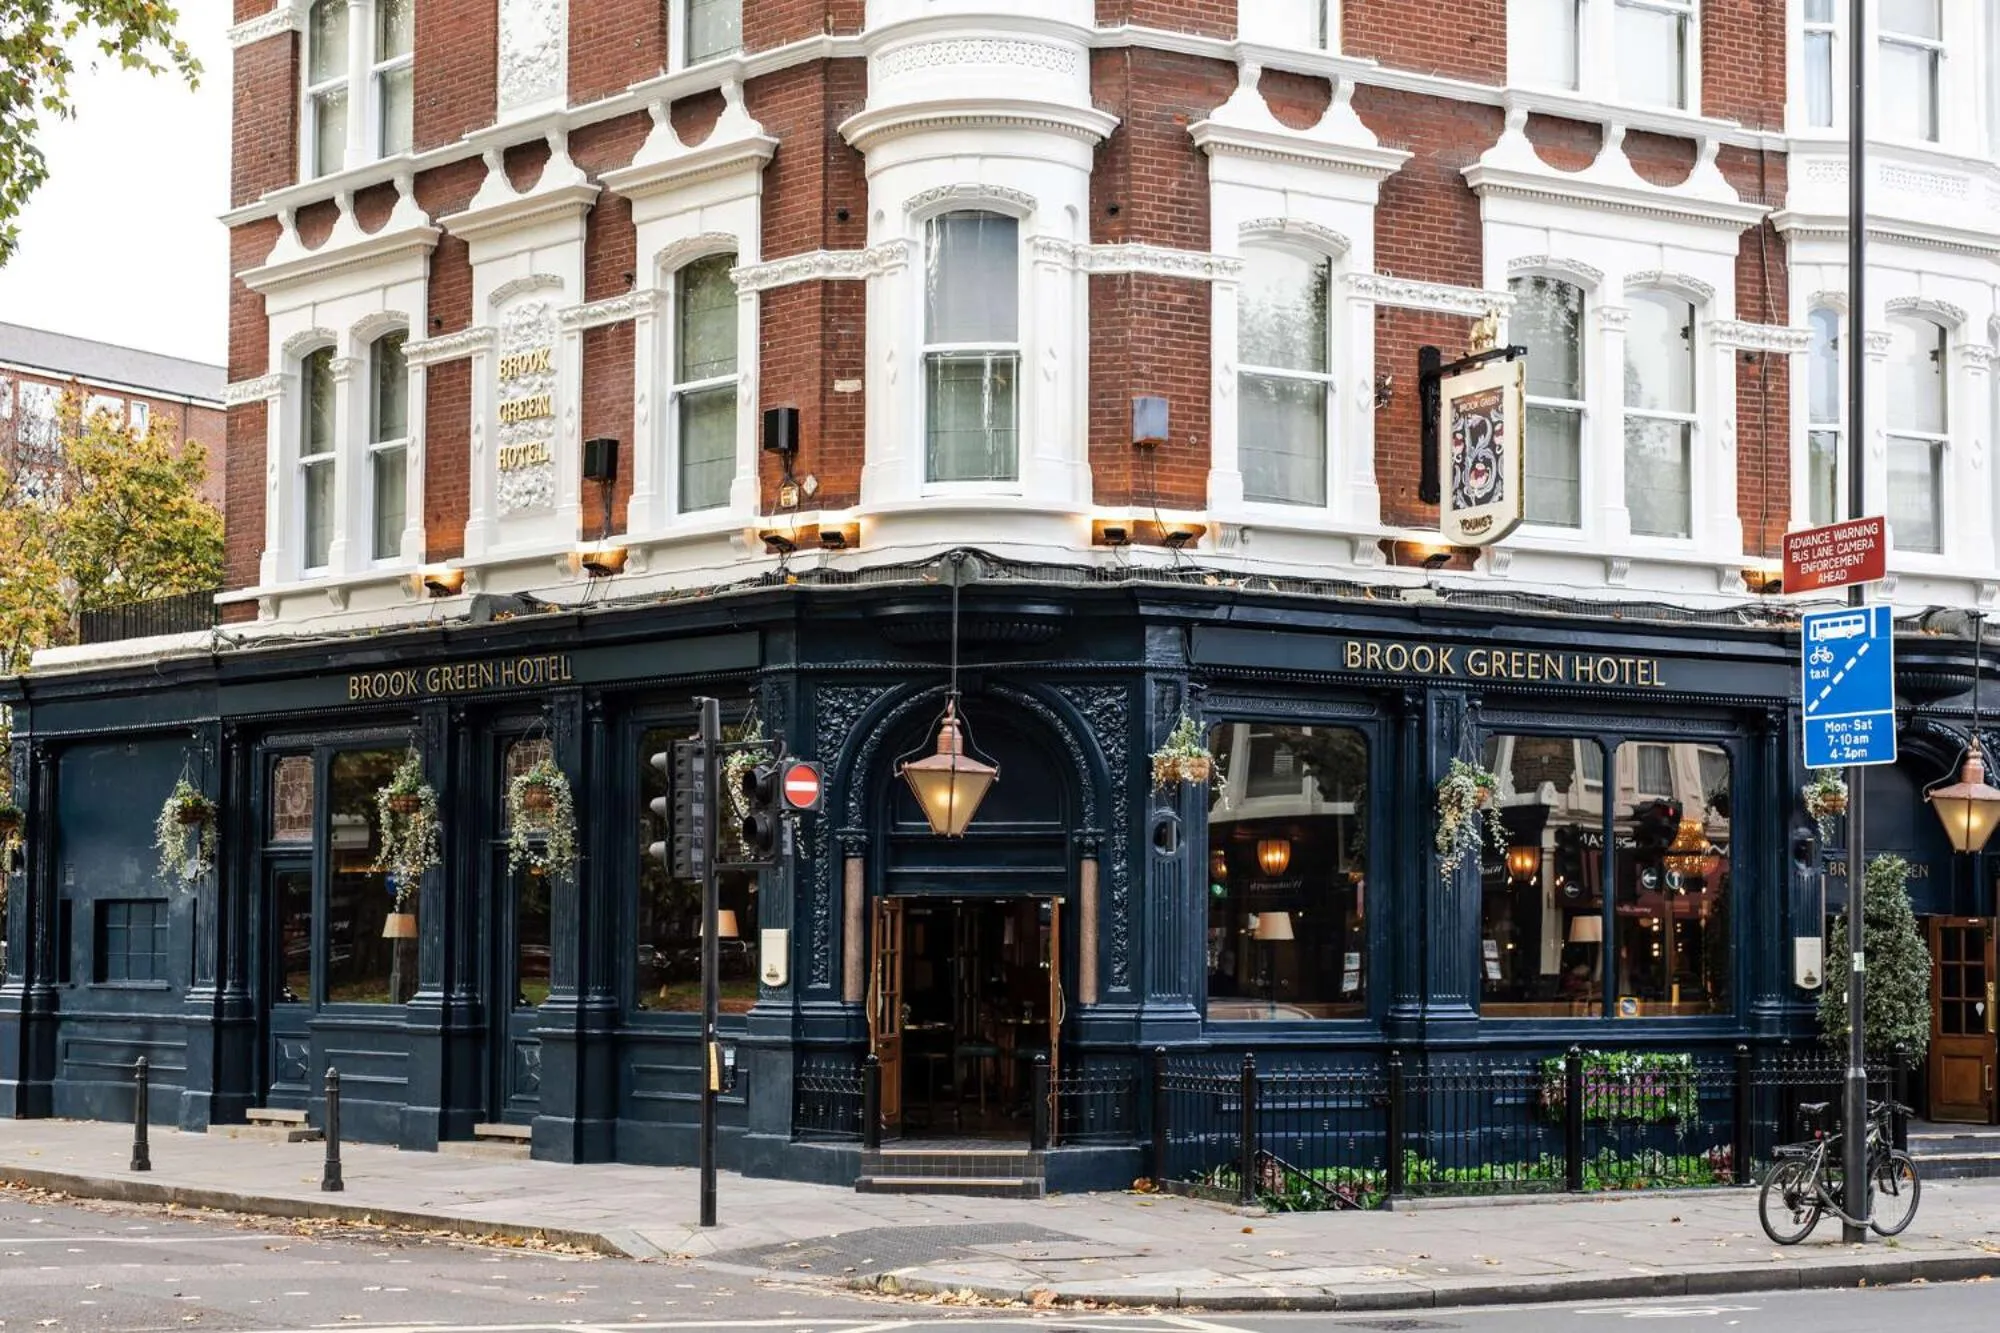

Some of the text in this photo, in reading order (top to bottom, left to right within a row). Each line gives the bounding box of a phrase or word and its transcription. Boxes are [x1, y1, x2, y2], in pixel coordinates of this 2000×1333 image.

[499, 347, 550, 379] BROOK
[499, 395, 551, 423] GREEN
[498, 441, 550, 471] HOTEL
[1789, 522, 1878, 549] ADVANCE WARNING
[1791, 538, 1875, 563] BUS LANE CAMERA
[1800, 553, 1865, 574] ENFORCEMENT
[1817, 569, 1848, 584] AHEAD
[1346, 640, 1666, 686] BROOK GREEN HOTEL
[1809, 667, 1830, 680] taxi
[349, 655, 572, 700] BROOK GREEN HOTEL
